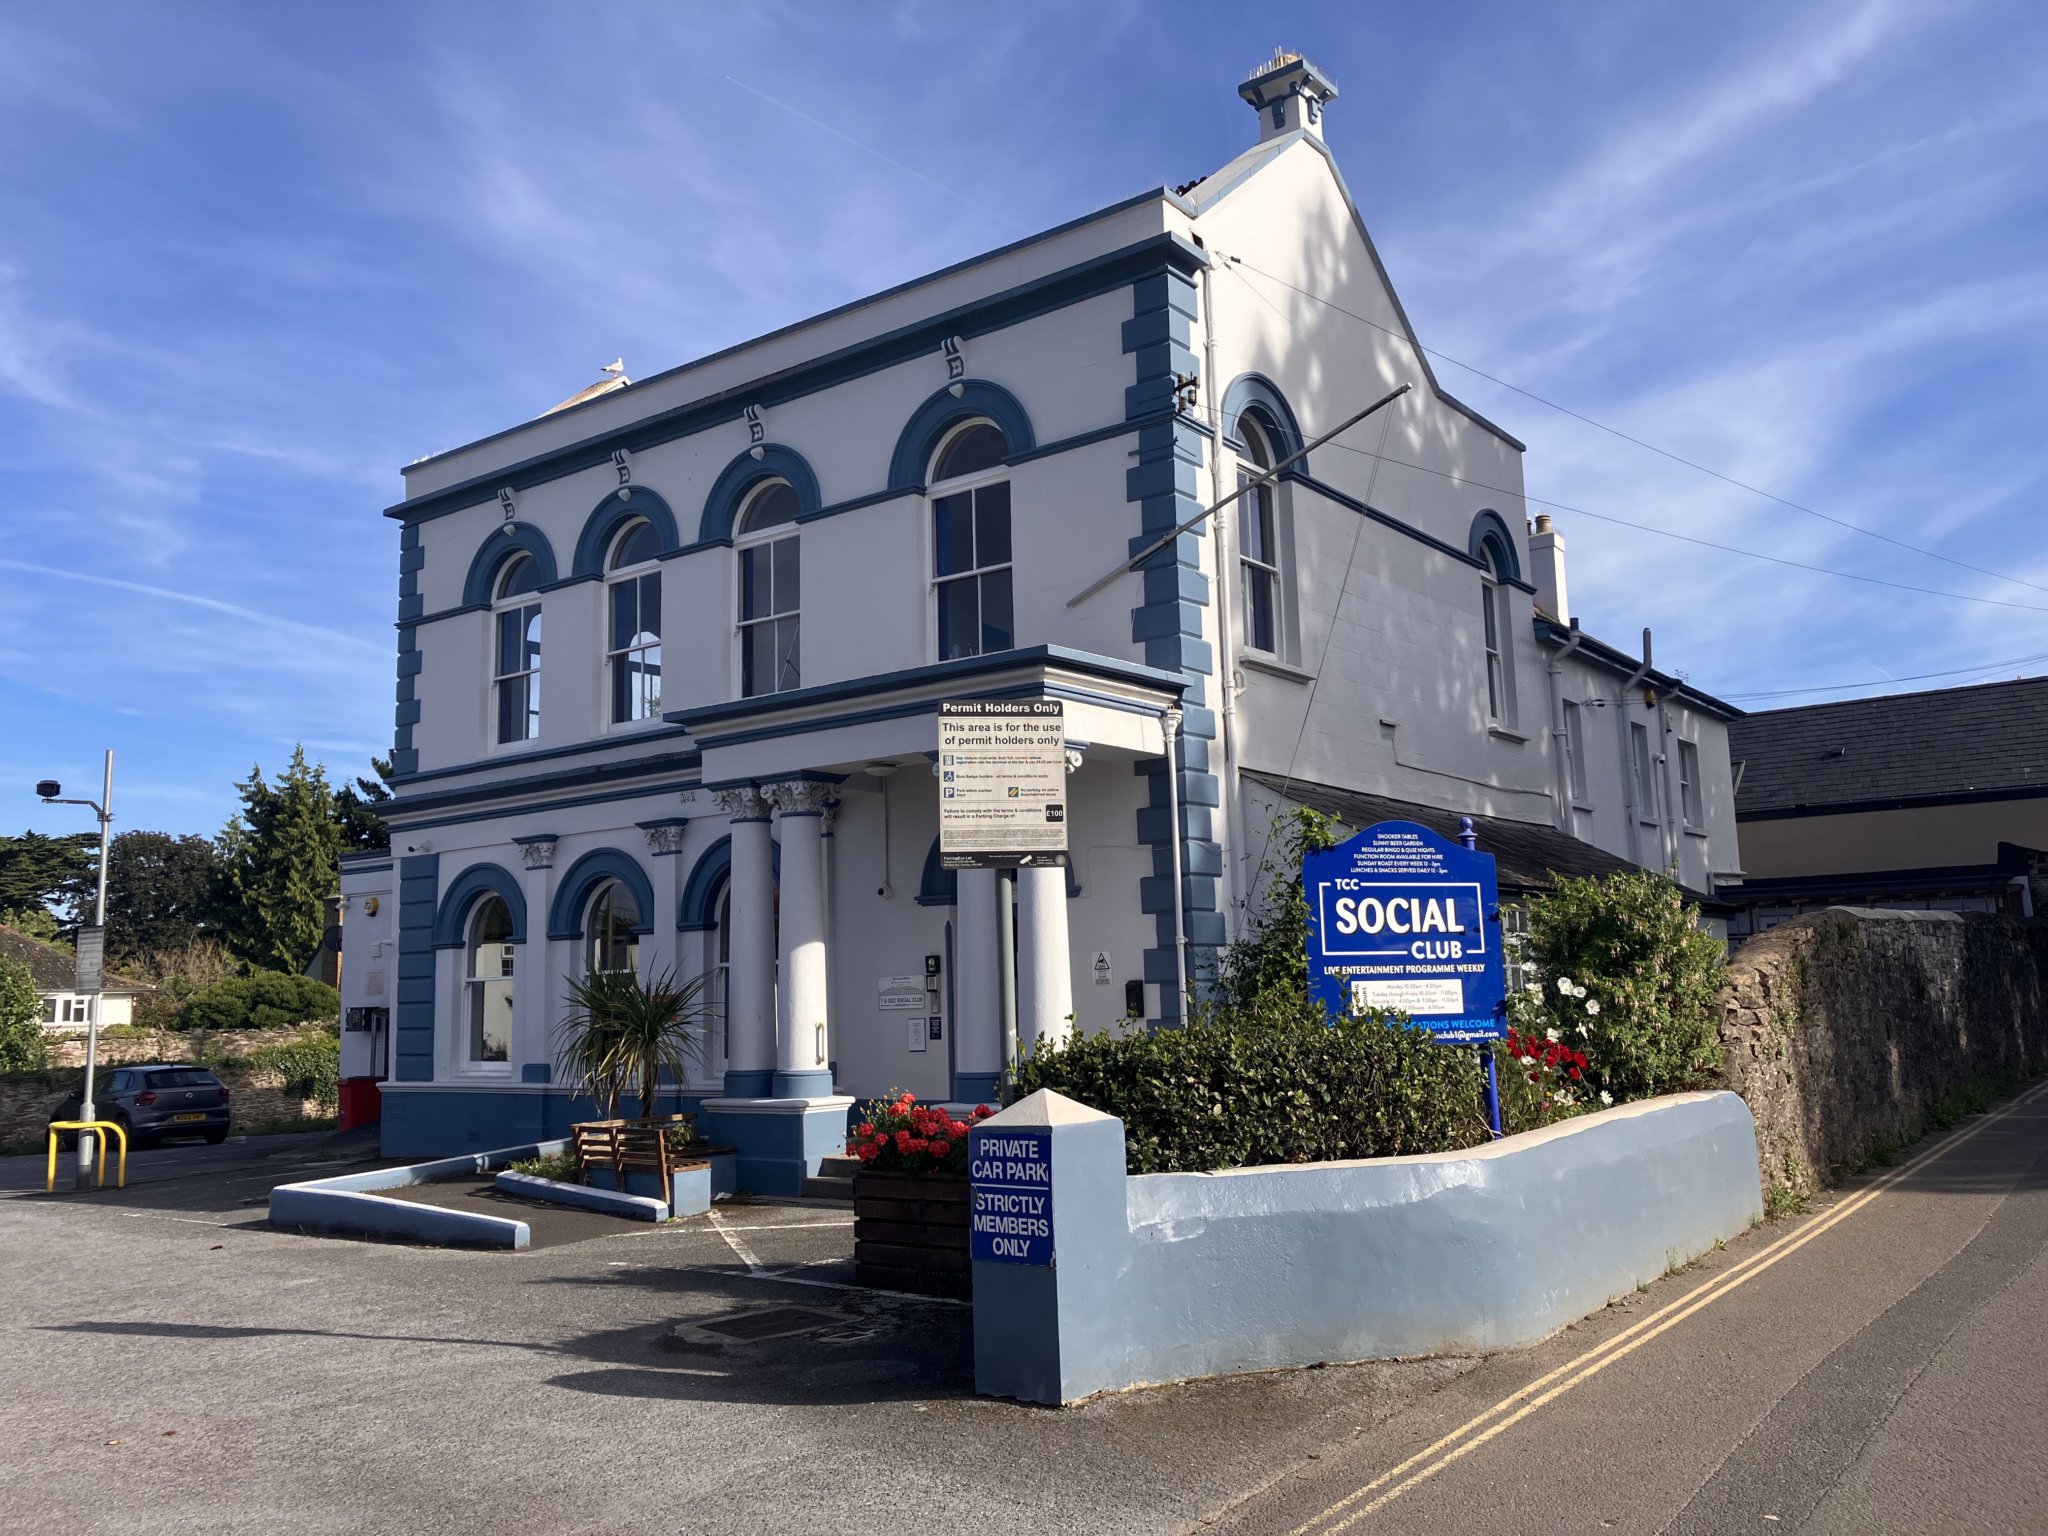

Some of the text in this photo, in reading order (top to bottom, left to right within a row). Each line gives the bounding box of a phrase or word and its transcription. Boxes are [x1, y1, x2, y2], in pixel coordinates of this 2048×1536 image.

[942, 703, 1060, 715] Permit Holders Only
[942, 722, 1062, 732] This area is for the use
[945, 736, 1060, 747] of permit holders only
[1334, 878, 1360, 890] TCC
[1335, 897, 1465, 934] SOCIAL
[1411, 940, 1463, 960] CLUB
[1324, 963, 1486, 975] LIVE ENTERTAINMENT PROGRAMME WEEKLY
[1450, 1018, 1496, 1029] WELCOME
[980, 1138, 1039, 1158] PRIVATE
[972, 1160, 1048, 1182] CAR PARK
[975, 1193, 1045, 1215] STRICTLY
[974, 1214, 1049, 1237] MEMBERS
[992, 1237, 1031, 1257] ONLY
